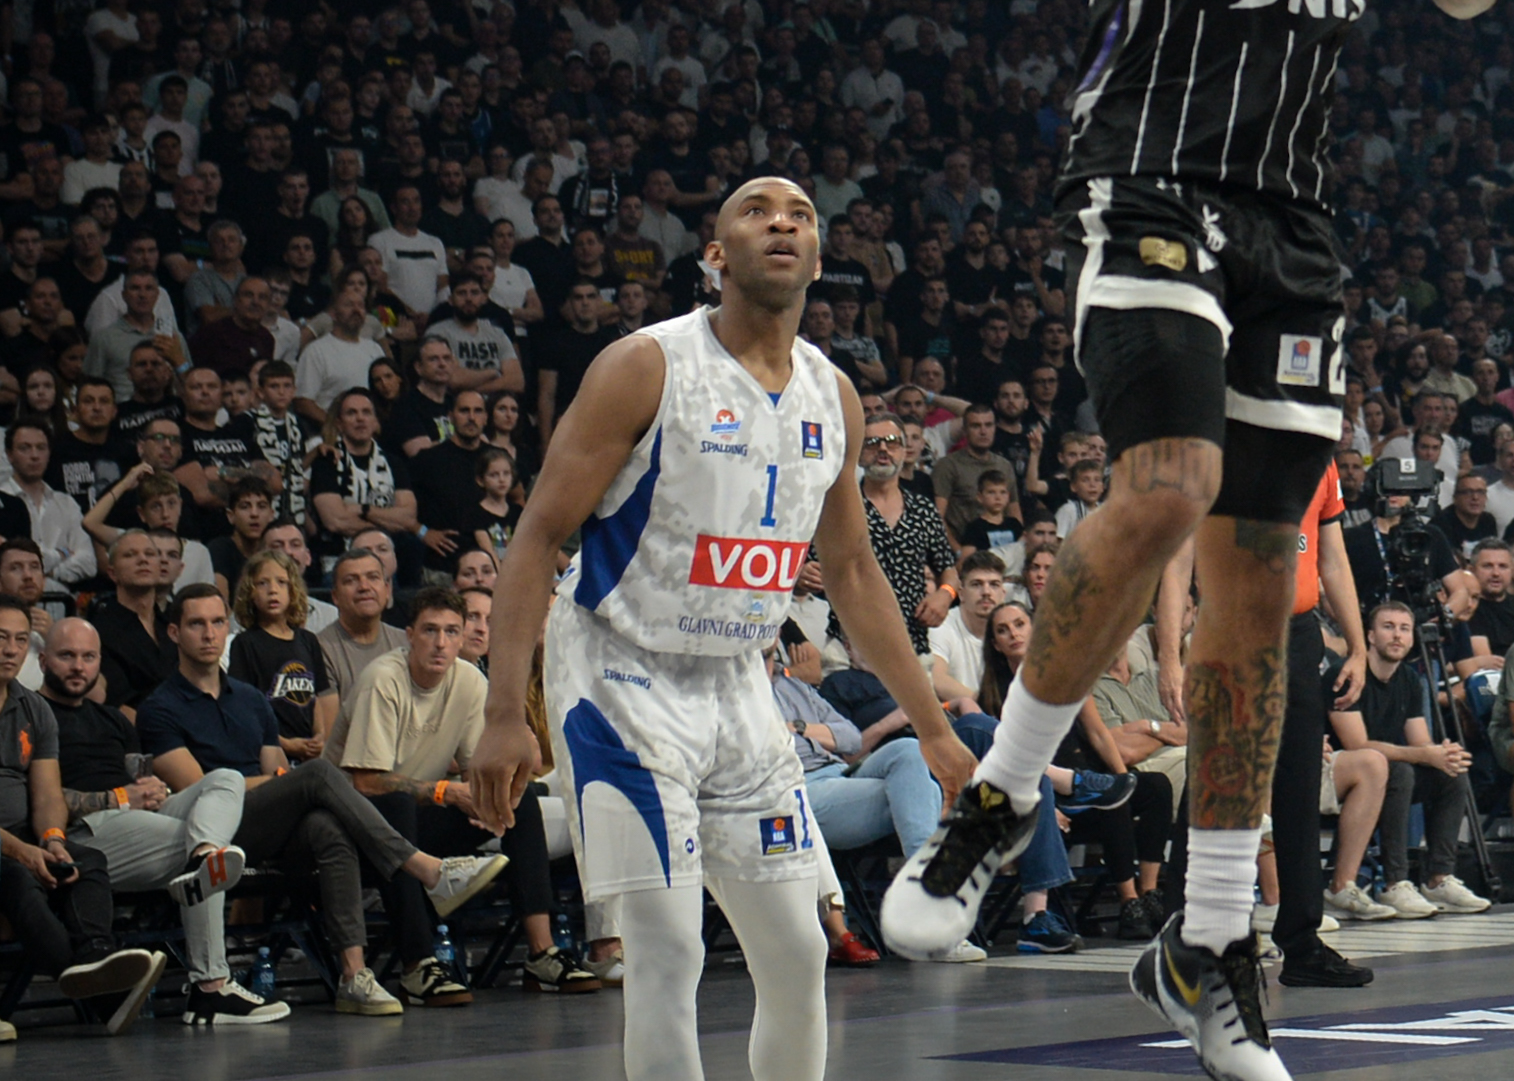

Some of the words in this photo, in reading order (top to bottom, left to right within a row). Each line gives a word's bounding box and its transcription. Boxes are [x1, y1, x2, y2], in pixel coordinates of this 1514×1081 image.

[700, 439, 749, 458] SPALDING
[759, 464, 779, 528] 1
[679, 615, 725, 637] GLAVNI
[725, 620, 758, 640] GRAD
[603, 668, 652, 690] SPALDING
[794, 788, 814, 850] 1
